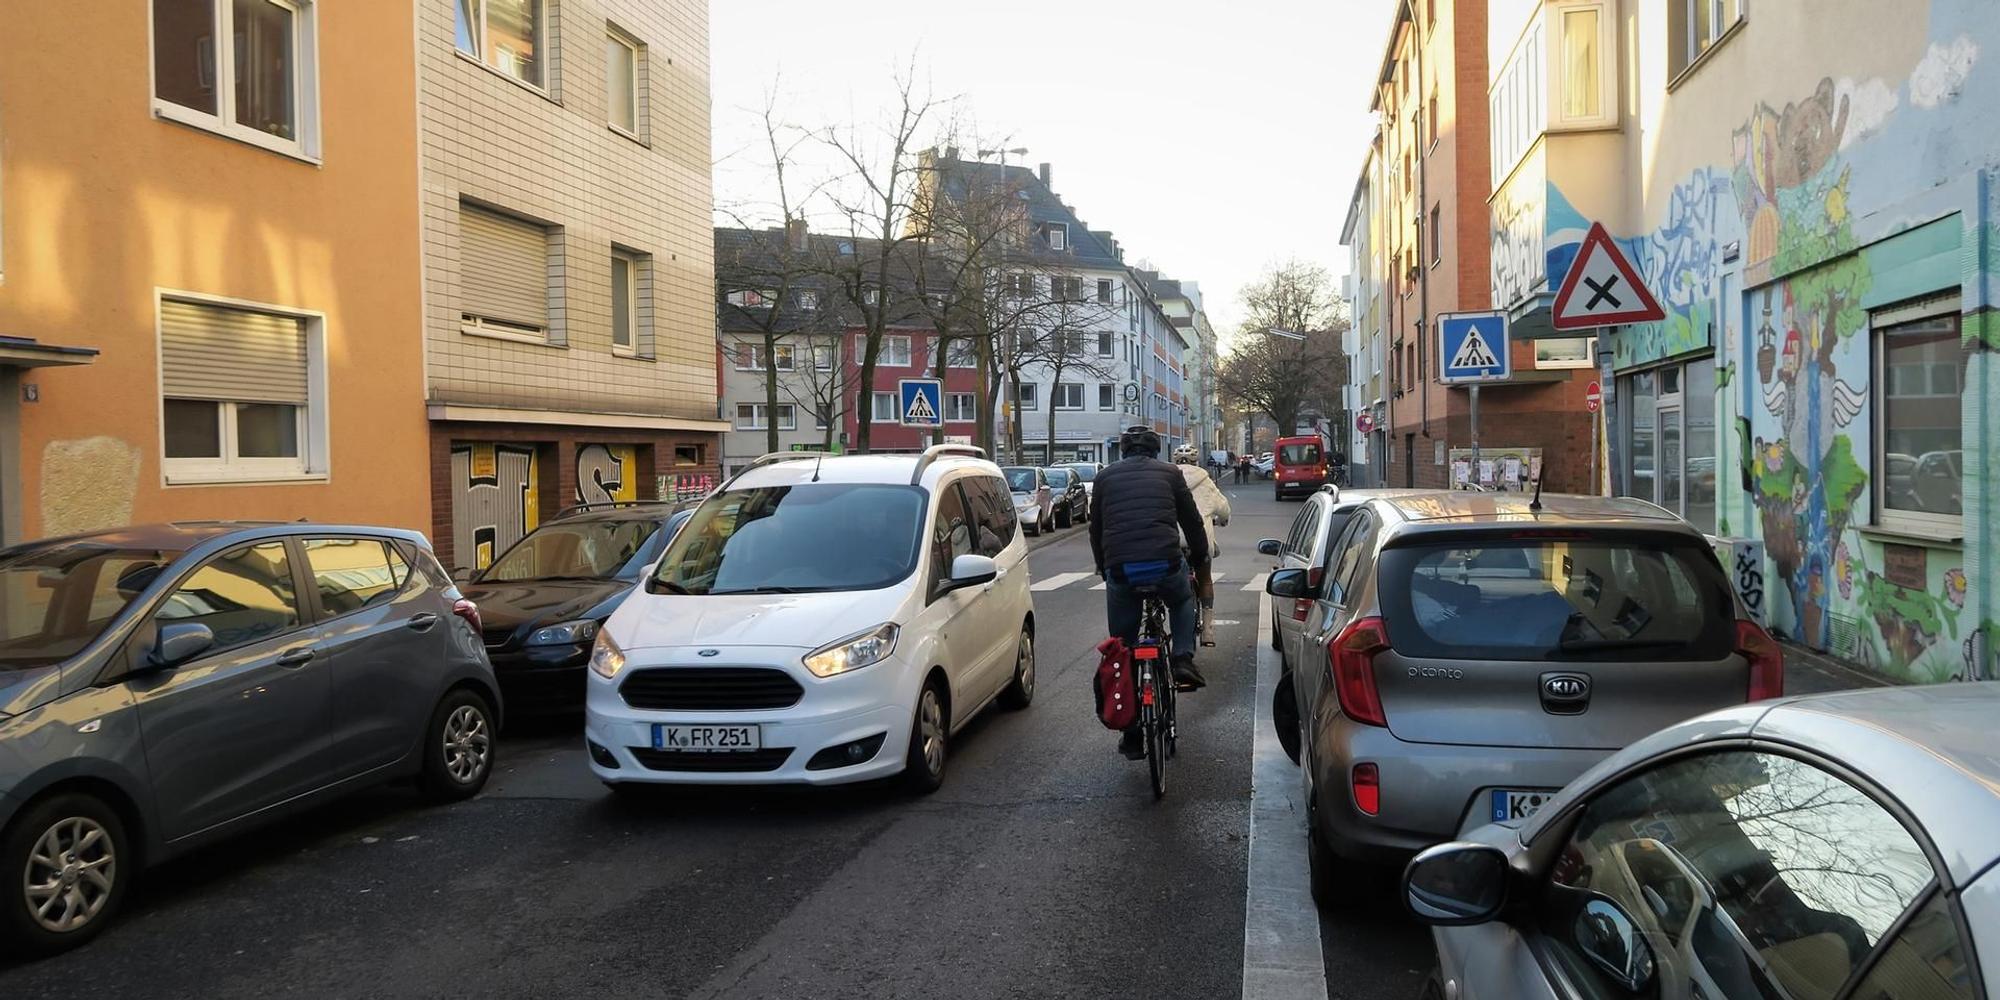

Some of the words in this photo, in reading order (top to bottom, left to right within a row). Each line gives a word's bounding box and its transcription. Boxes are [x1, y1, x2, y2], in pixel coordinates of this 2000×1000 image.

[1408, 666, 1464, 680] picanto
[1552, 681, 1581, 694] KIA
[667, 728, 680, 746] K
[691, 728, 714, 746] FR
[718, 728, 752, 746] 251
[1510, 795, 1526, 819] K
